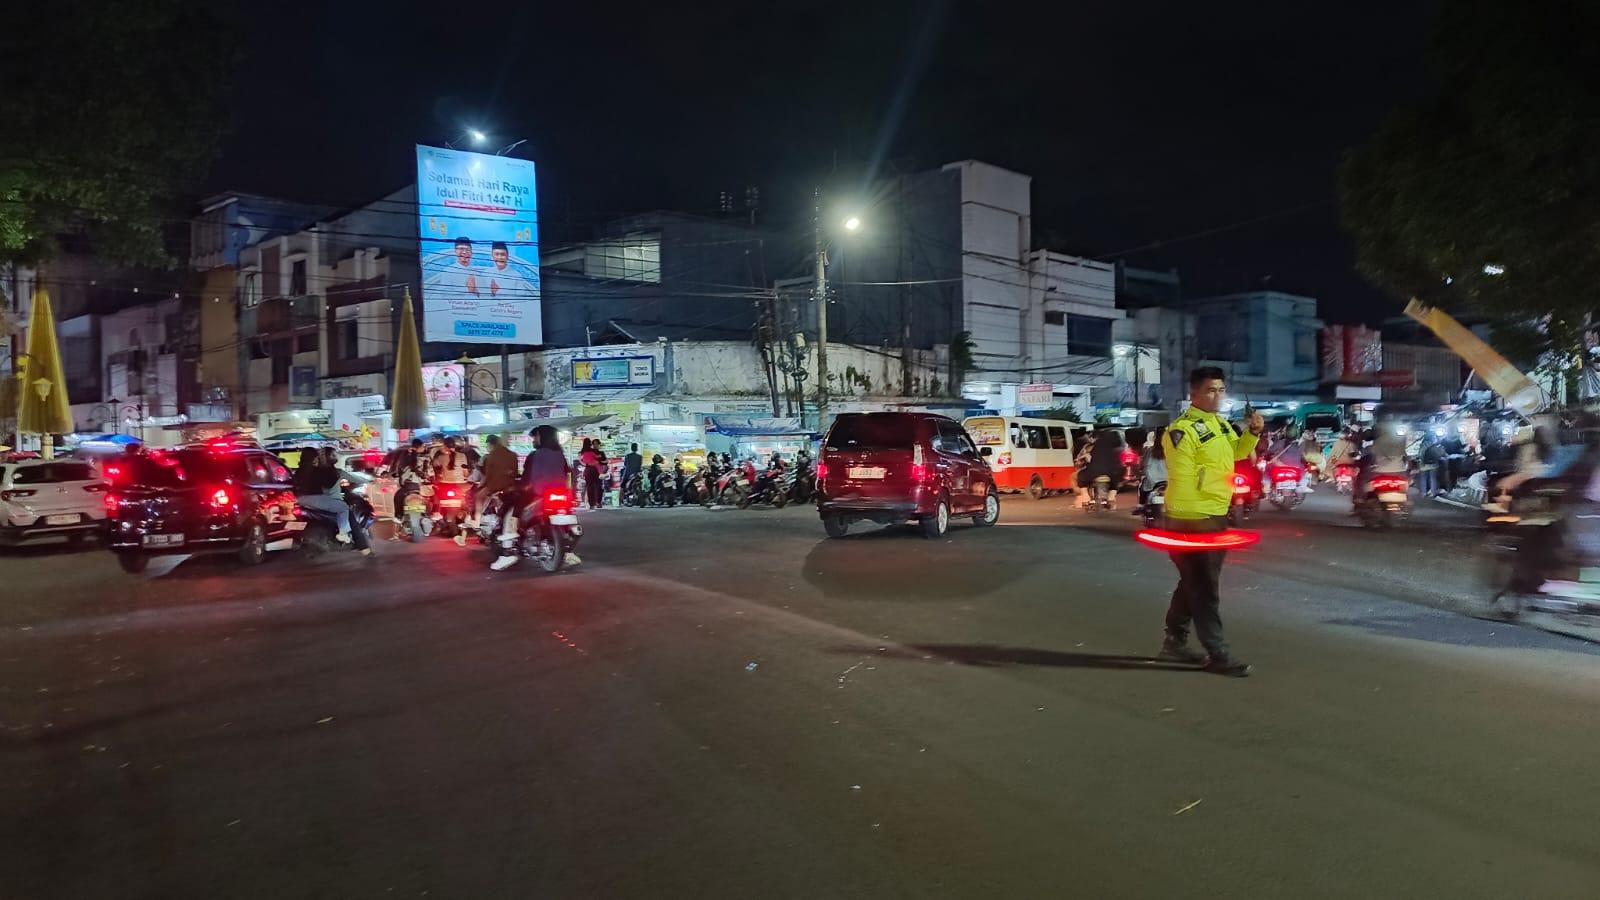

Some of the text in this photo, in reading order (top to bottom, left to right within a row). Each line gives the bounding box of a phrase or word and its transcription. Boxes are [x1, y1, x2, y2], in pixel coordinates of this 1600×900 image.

[428, 171, 529, 195] Selamat Hari Raya
[436, 187, 458, 199] Idul
[461, 190, 483, 202] Fitri
[487, 194, 511, 206] 1447
[515, 196, 523, 207] H
